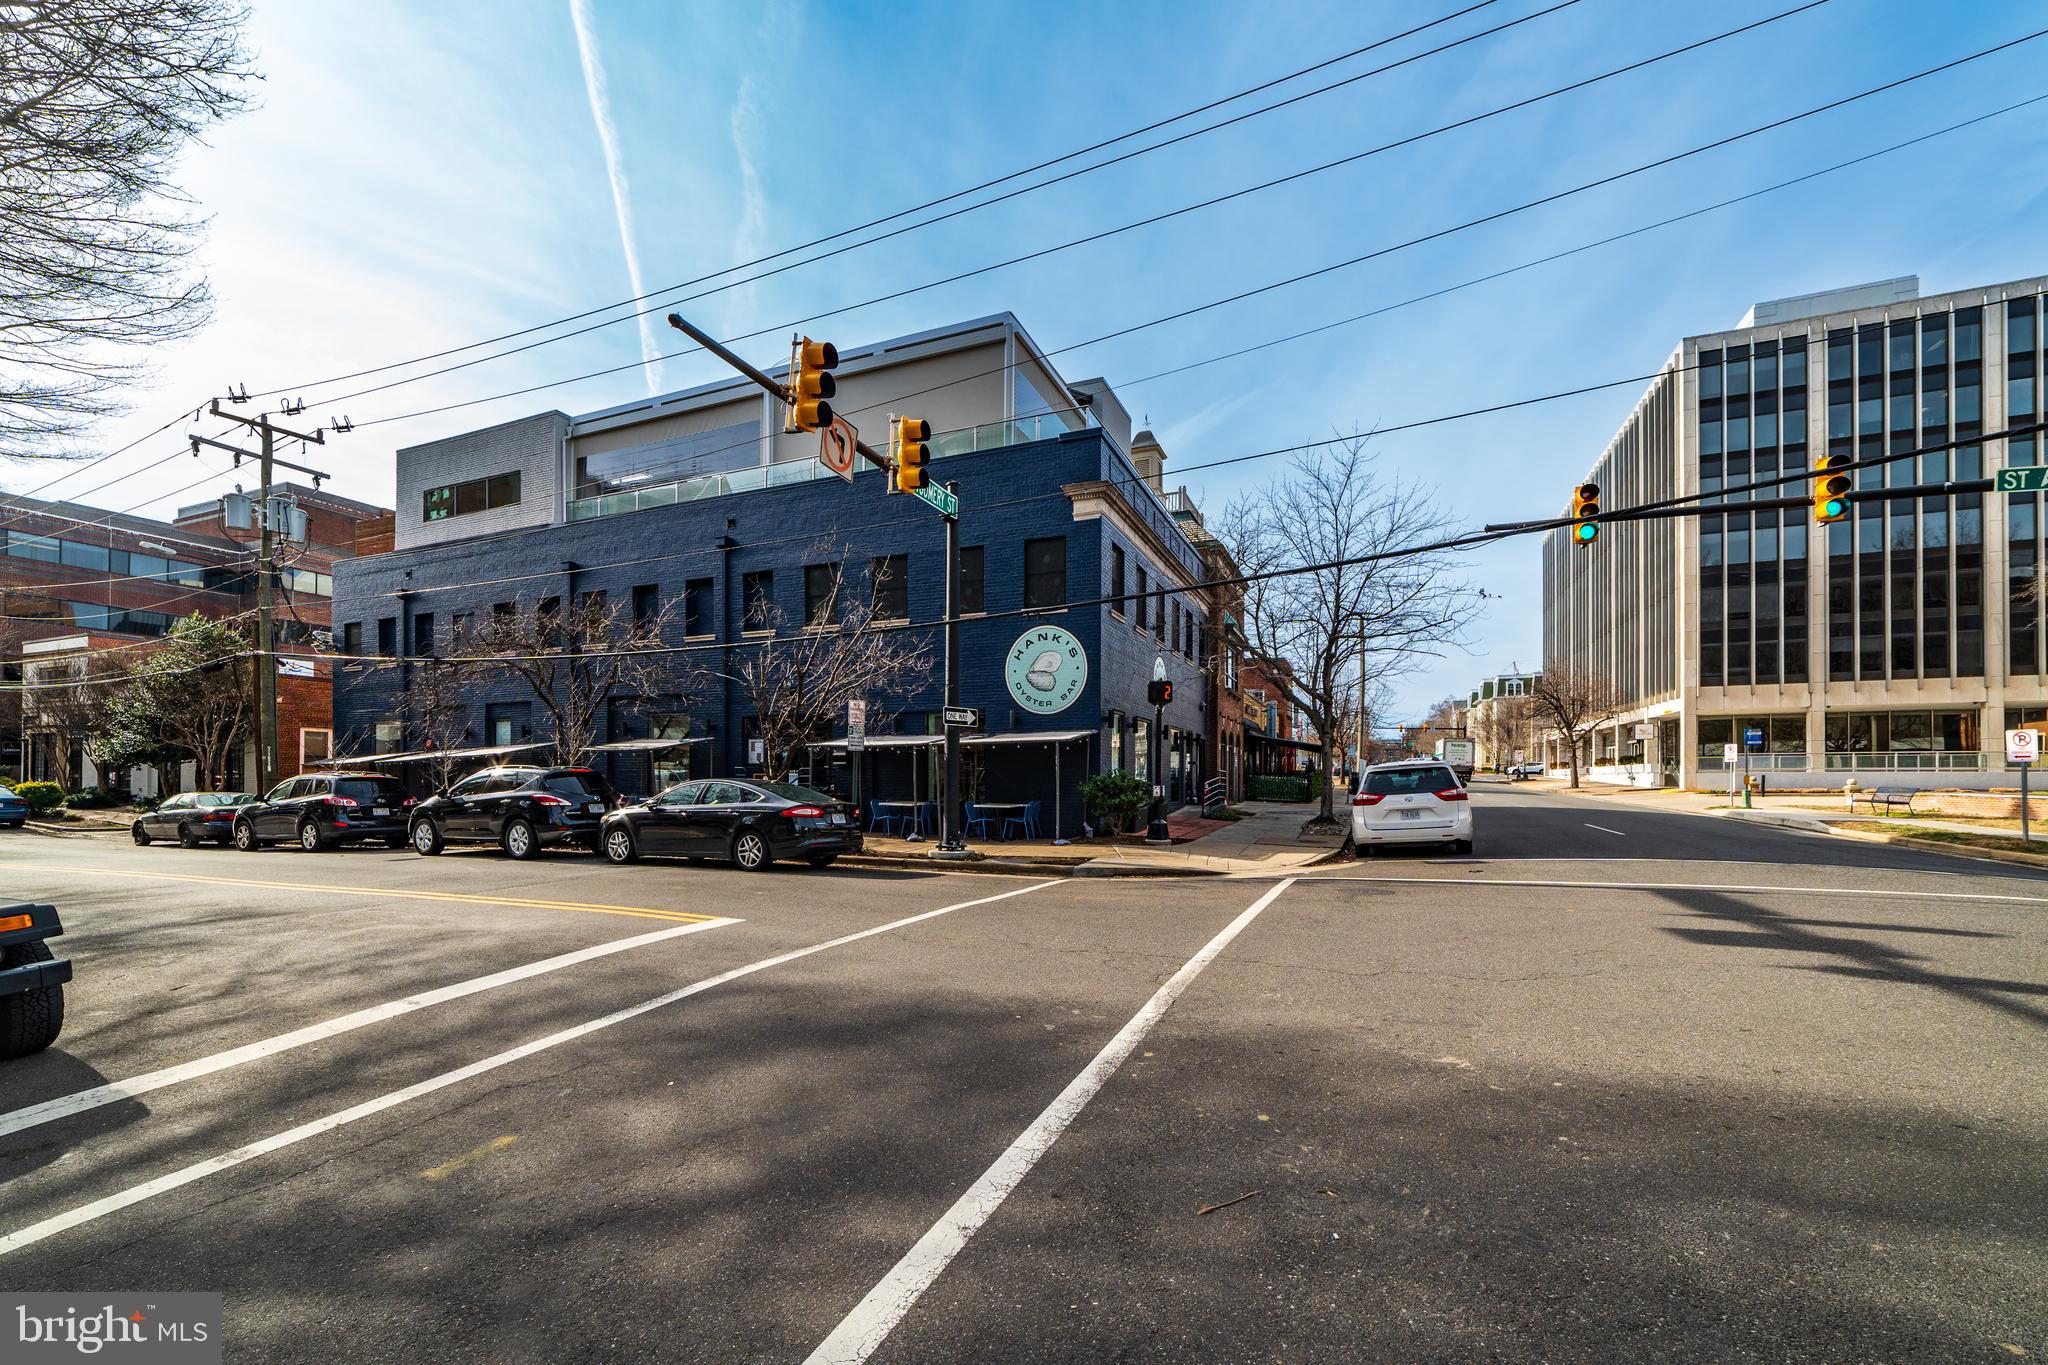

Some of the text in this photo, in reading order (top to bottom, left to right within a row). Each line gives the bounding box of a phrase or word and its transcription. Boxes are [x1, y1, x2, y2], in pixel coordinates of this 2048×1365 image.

[2003, 470, 2030, 490] ST
[947, 496, 956, 514] ST
[1014, 632, 1078, 660] HANK'S
[1015, 679, 1078, 708] OYSTER BAR
[947, 712, 968, 721] ONE WAY
